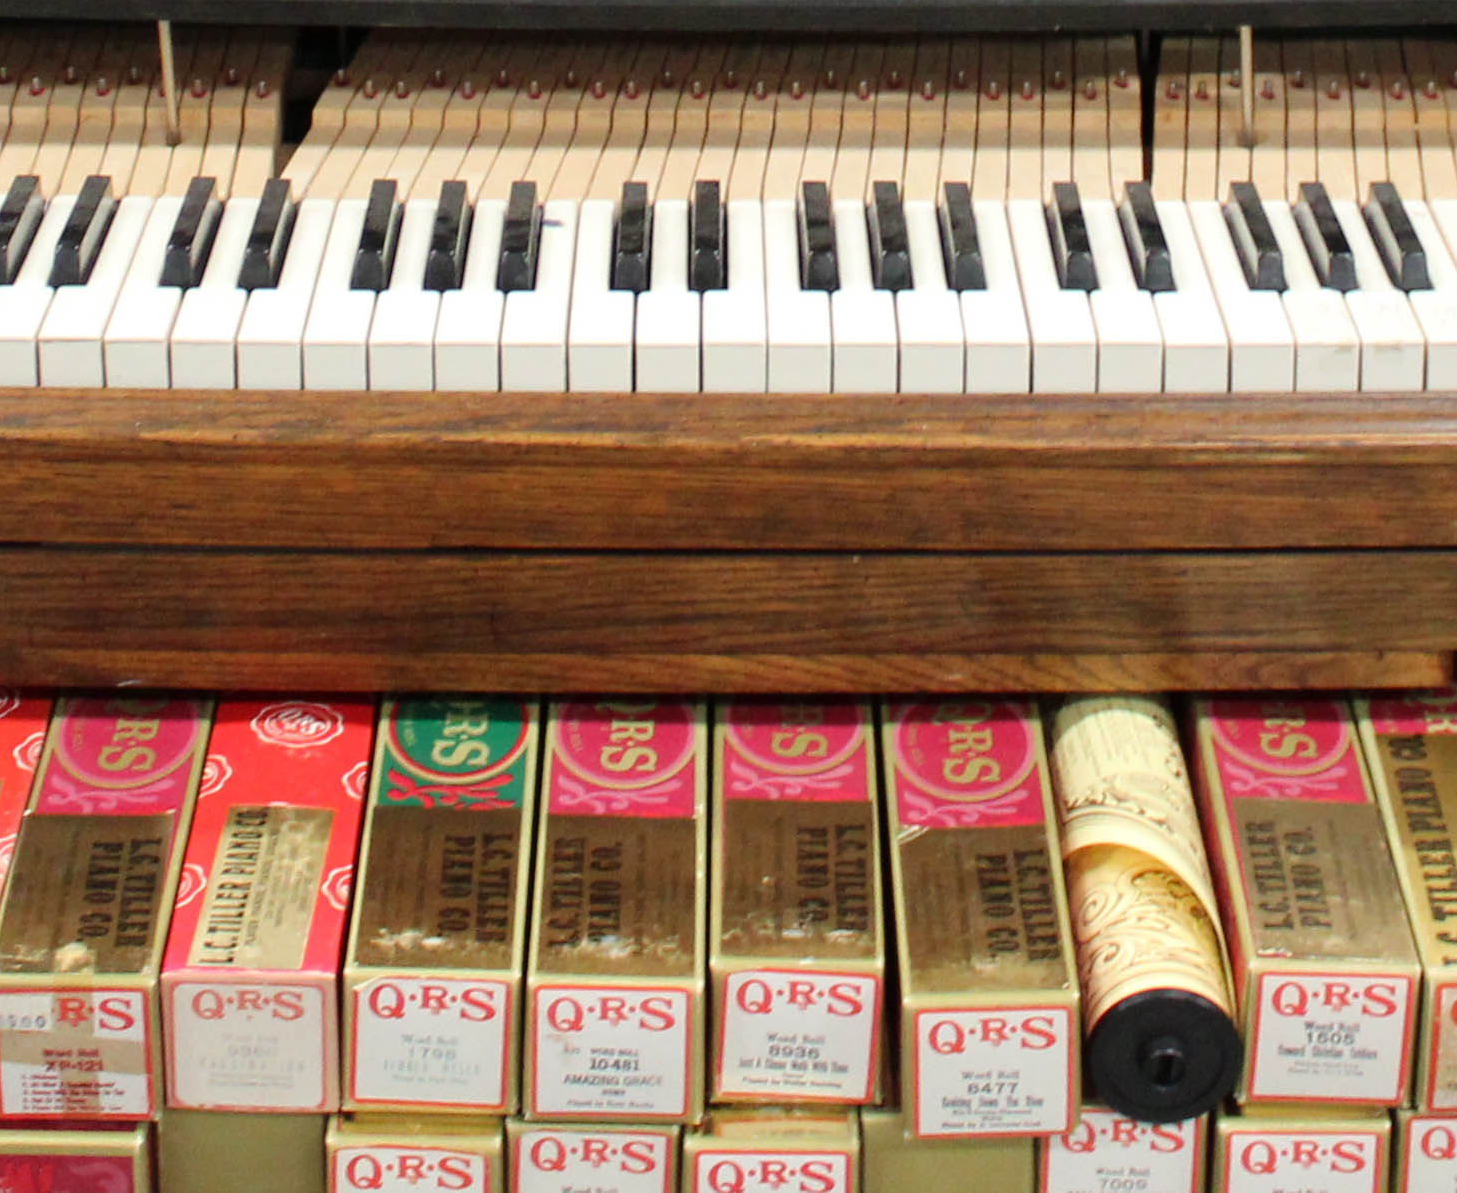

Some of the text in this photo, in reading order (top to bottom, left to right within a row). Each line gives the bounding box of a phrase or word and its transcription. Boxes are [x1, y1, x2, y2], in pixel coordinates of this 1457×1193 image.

[1395, 766, 1449, 836] PIANO
[220, 829, 264, 876] PIANO
[441, 834, 477, 899] PIANO
[551, 837, 585, 909] TILLER
[795, 826, 830, 890] PIANO
[974, 853, 1016, 920] PIANO
[1244, 821, 1288, 895] TILLER
[1282, 824, 1334, 929] PIANO CO.
[75, 841, 125, 943] PIANO CO.
[114, 873, 157, 948] TILLER
[207, 881, 252, 934] TILLER
[474, 867, 511, 944] TILLER
[588, 879, 622, 944] PIANO
[834, 857, 869, 931] TILLER
[1017, 883, 1062, 961] TILLER
[766, 1032, 797, 1045] Word
[1304, 1021, 1361, 1032] Word Roll
[563, 1073, 664, 1087] AMAZING GRACE
